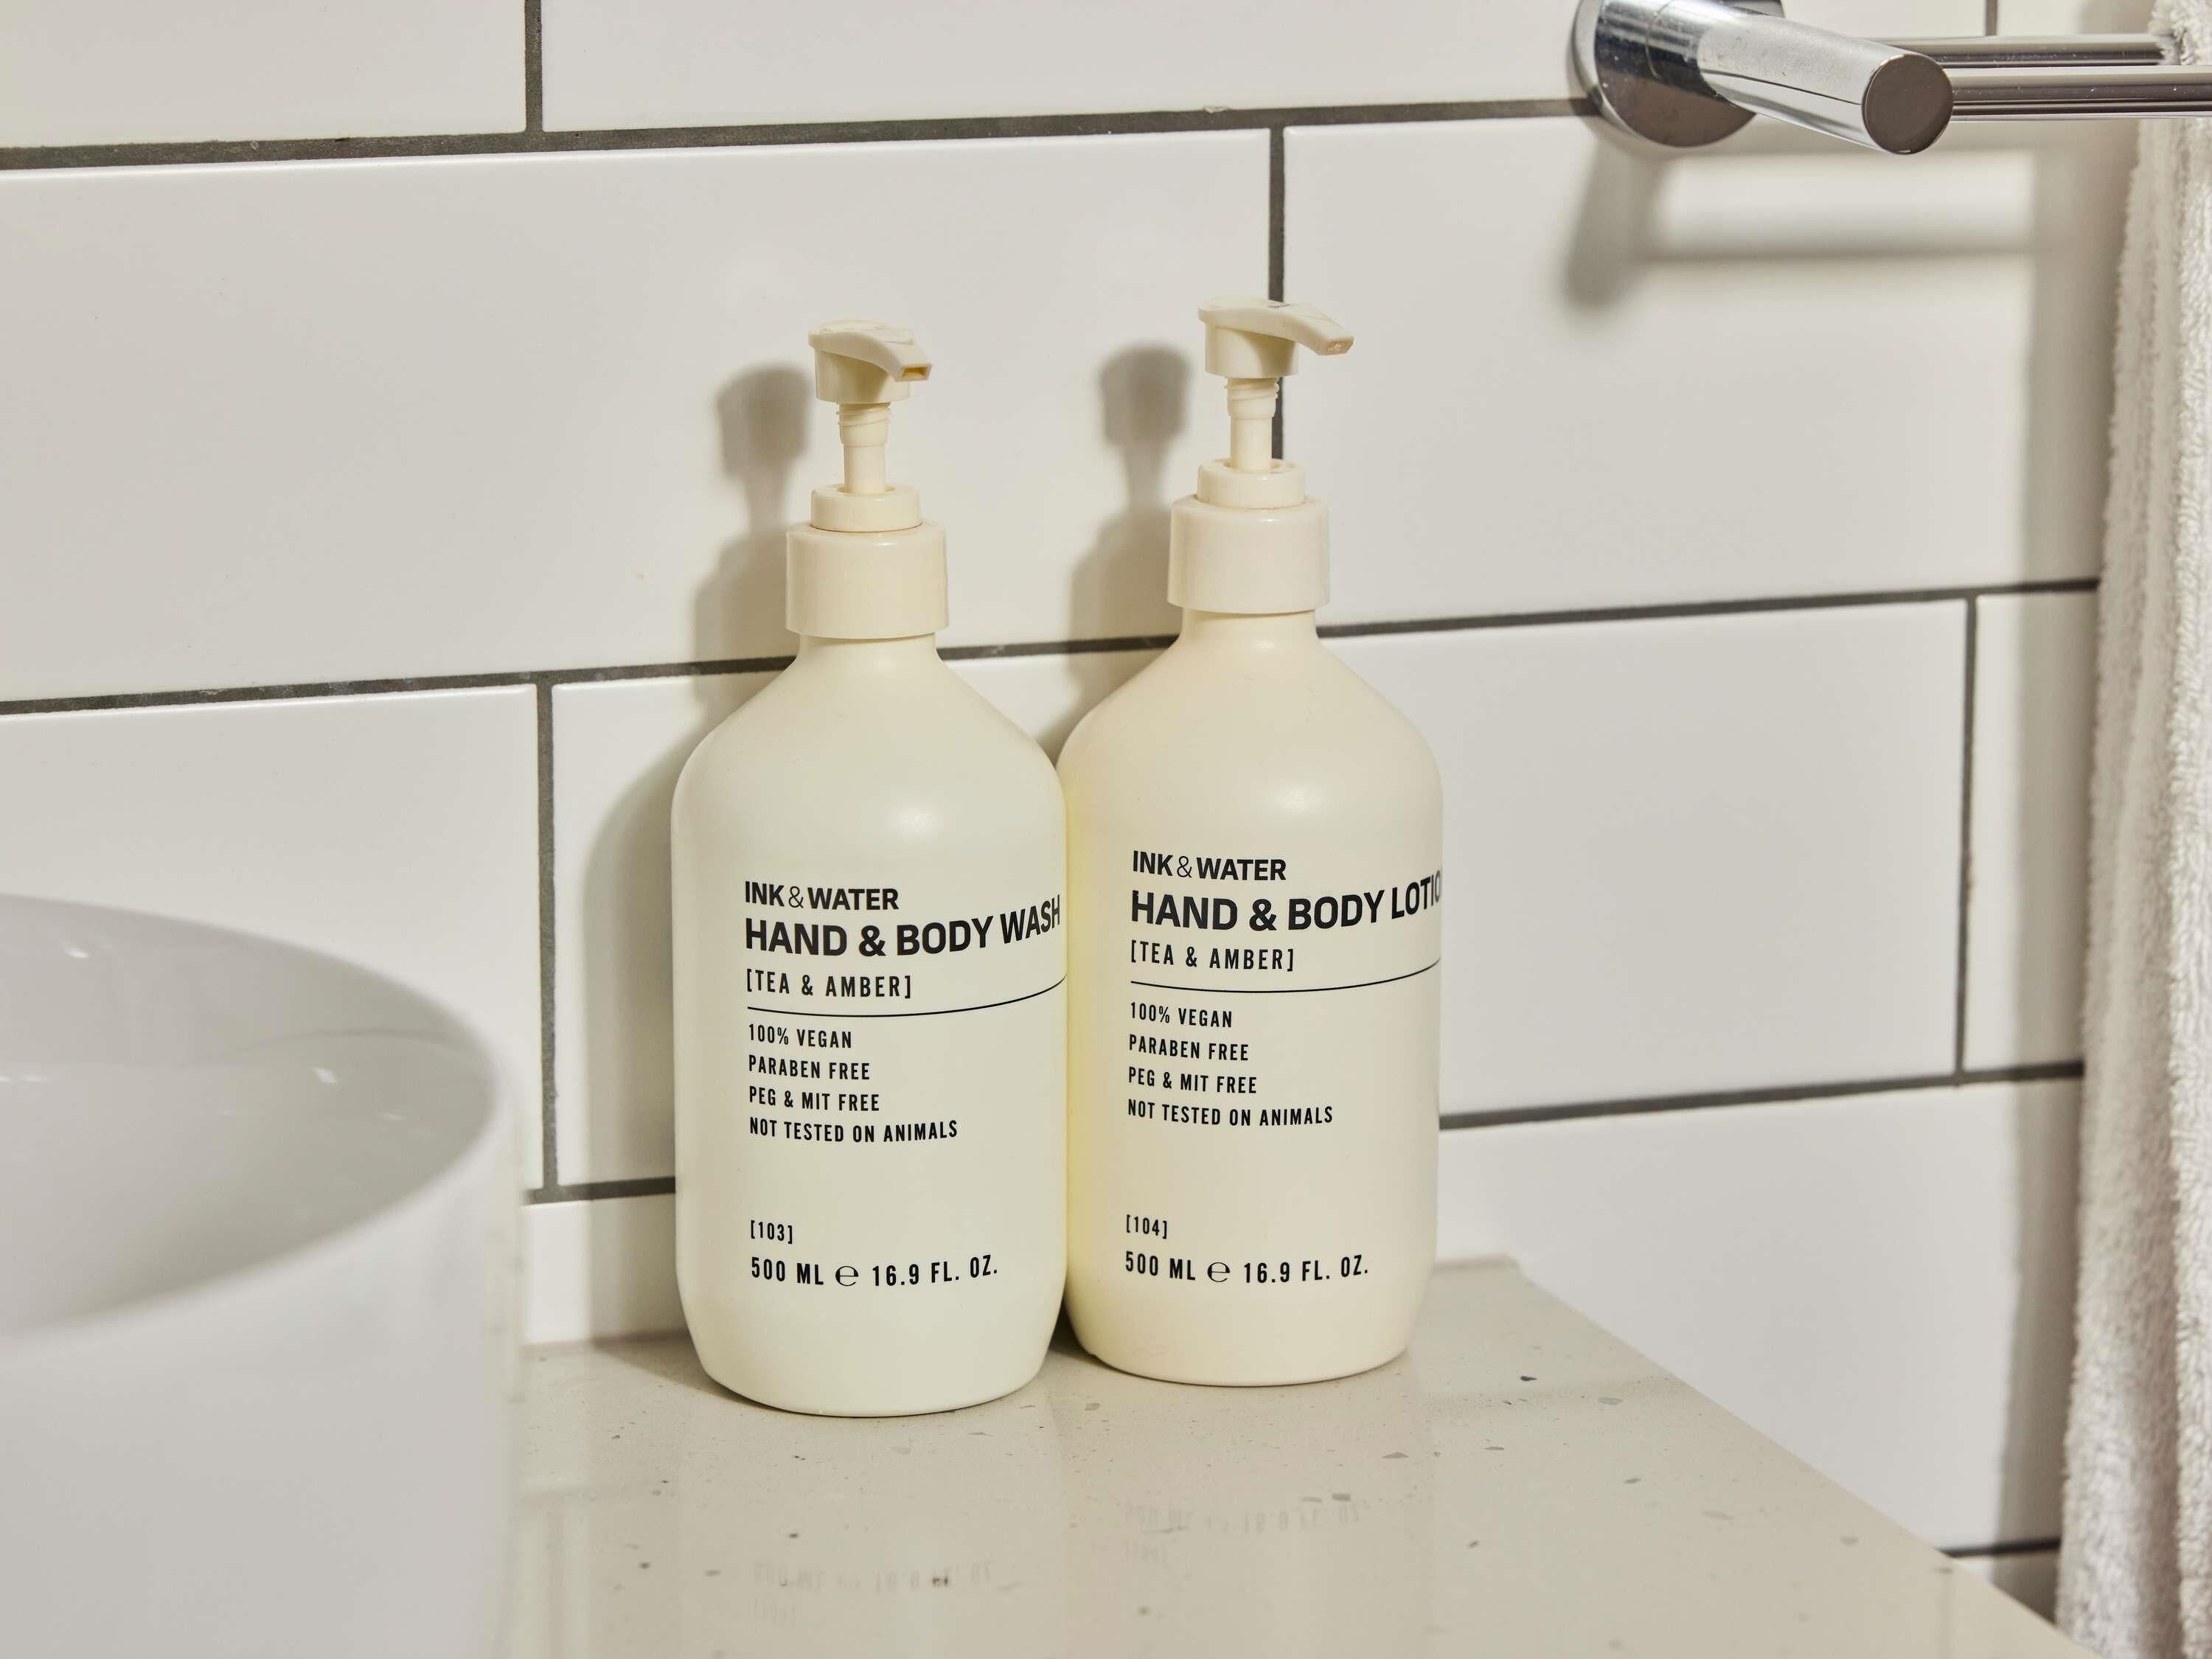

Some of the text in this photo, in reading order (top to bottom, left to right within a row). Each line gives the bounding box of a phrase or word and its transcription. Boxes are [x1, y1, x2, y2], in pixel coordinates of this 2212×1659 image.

[1133, 850, 1287, 881] INK&WATER
[745, 880, 900, 911] INK&WATER
[1131, 868, 1442, 932] HAND & BODY LOTIO
[745, 894, 1060, 957] HAND & BODY WASH
[1130, 939, 1294, 973] [TEA & AMBER]
[746, 968, 911, 1000] [TEA & AMBER]
[1130, 1001, 1232, 1029] 100% VEGAN
[748, 1023, 852, 1049] 100% VEGAN
[1129, 1033, 1249, 1061] PARABEN FREE
[748, 1054, 870, 1080] PARABEN FREE
[1128, 1065, 1257, 1094] PEG & MIT FREE
[749, 1085, 880, 1112] PEG & MIT FREE
[1127, 1098, 1333, 1127] NOT TESTED ON ANIMALS
[749, 1116, 958, 1144] NOT TESTED ON ANIMALS
[750, 1220, 793, 1245] [103]
[1126, 1214, 1168, 1240] [104]
[751, 1256, 786, 1282] 500
[796, 1262, 824, 1286] ML
[872, 1263, 919, 1287] 16.9
[931, 1261, 959, 1284] FL.
[970, 1253, 998, 1279] OZ.
[1125, 1251, 1159, 1277] 500
[1169, 1257, 1196, 1281] ML
[1243, 1262, 1290, 1284] 16.9
[1301, 1259, 1330, 1282] FL.
[1340, 1253, 1368, 1278] OZ.
